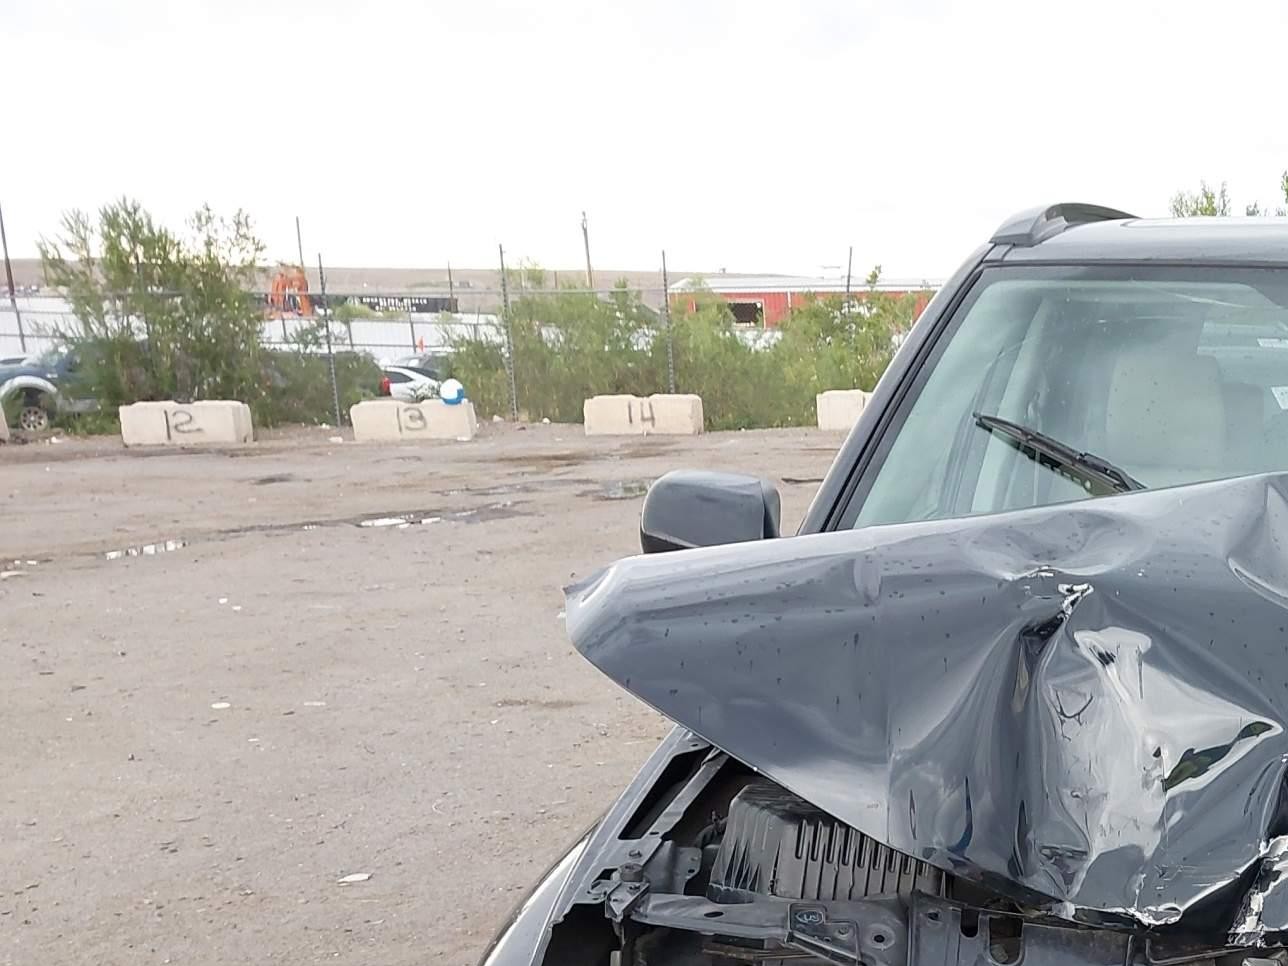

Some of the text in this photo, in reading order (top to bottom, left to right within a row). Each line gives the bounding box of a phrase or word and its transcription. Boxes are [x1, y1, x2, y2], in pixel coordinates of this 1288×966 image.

[164, 408, 204, 440] 12
[396, 407, 427, 432] 13
[628, 401, 655, 427] 14
